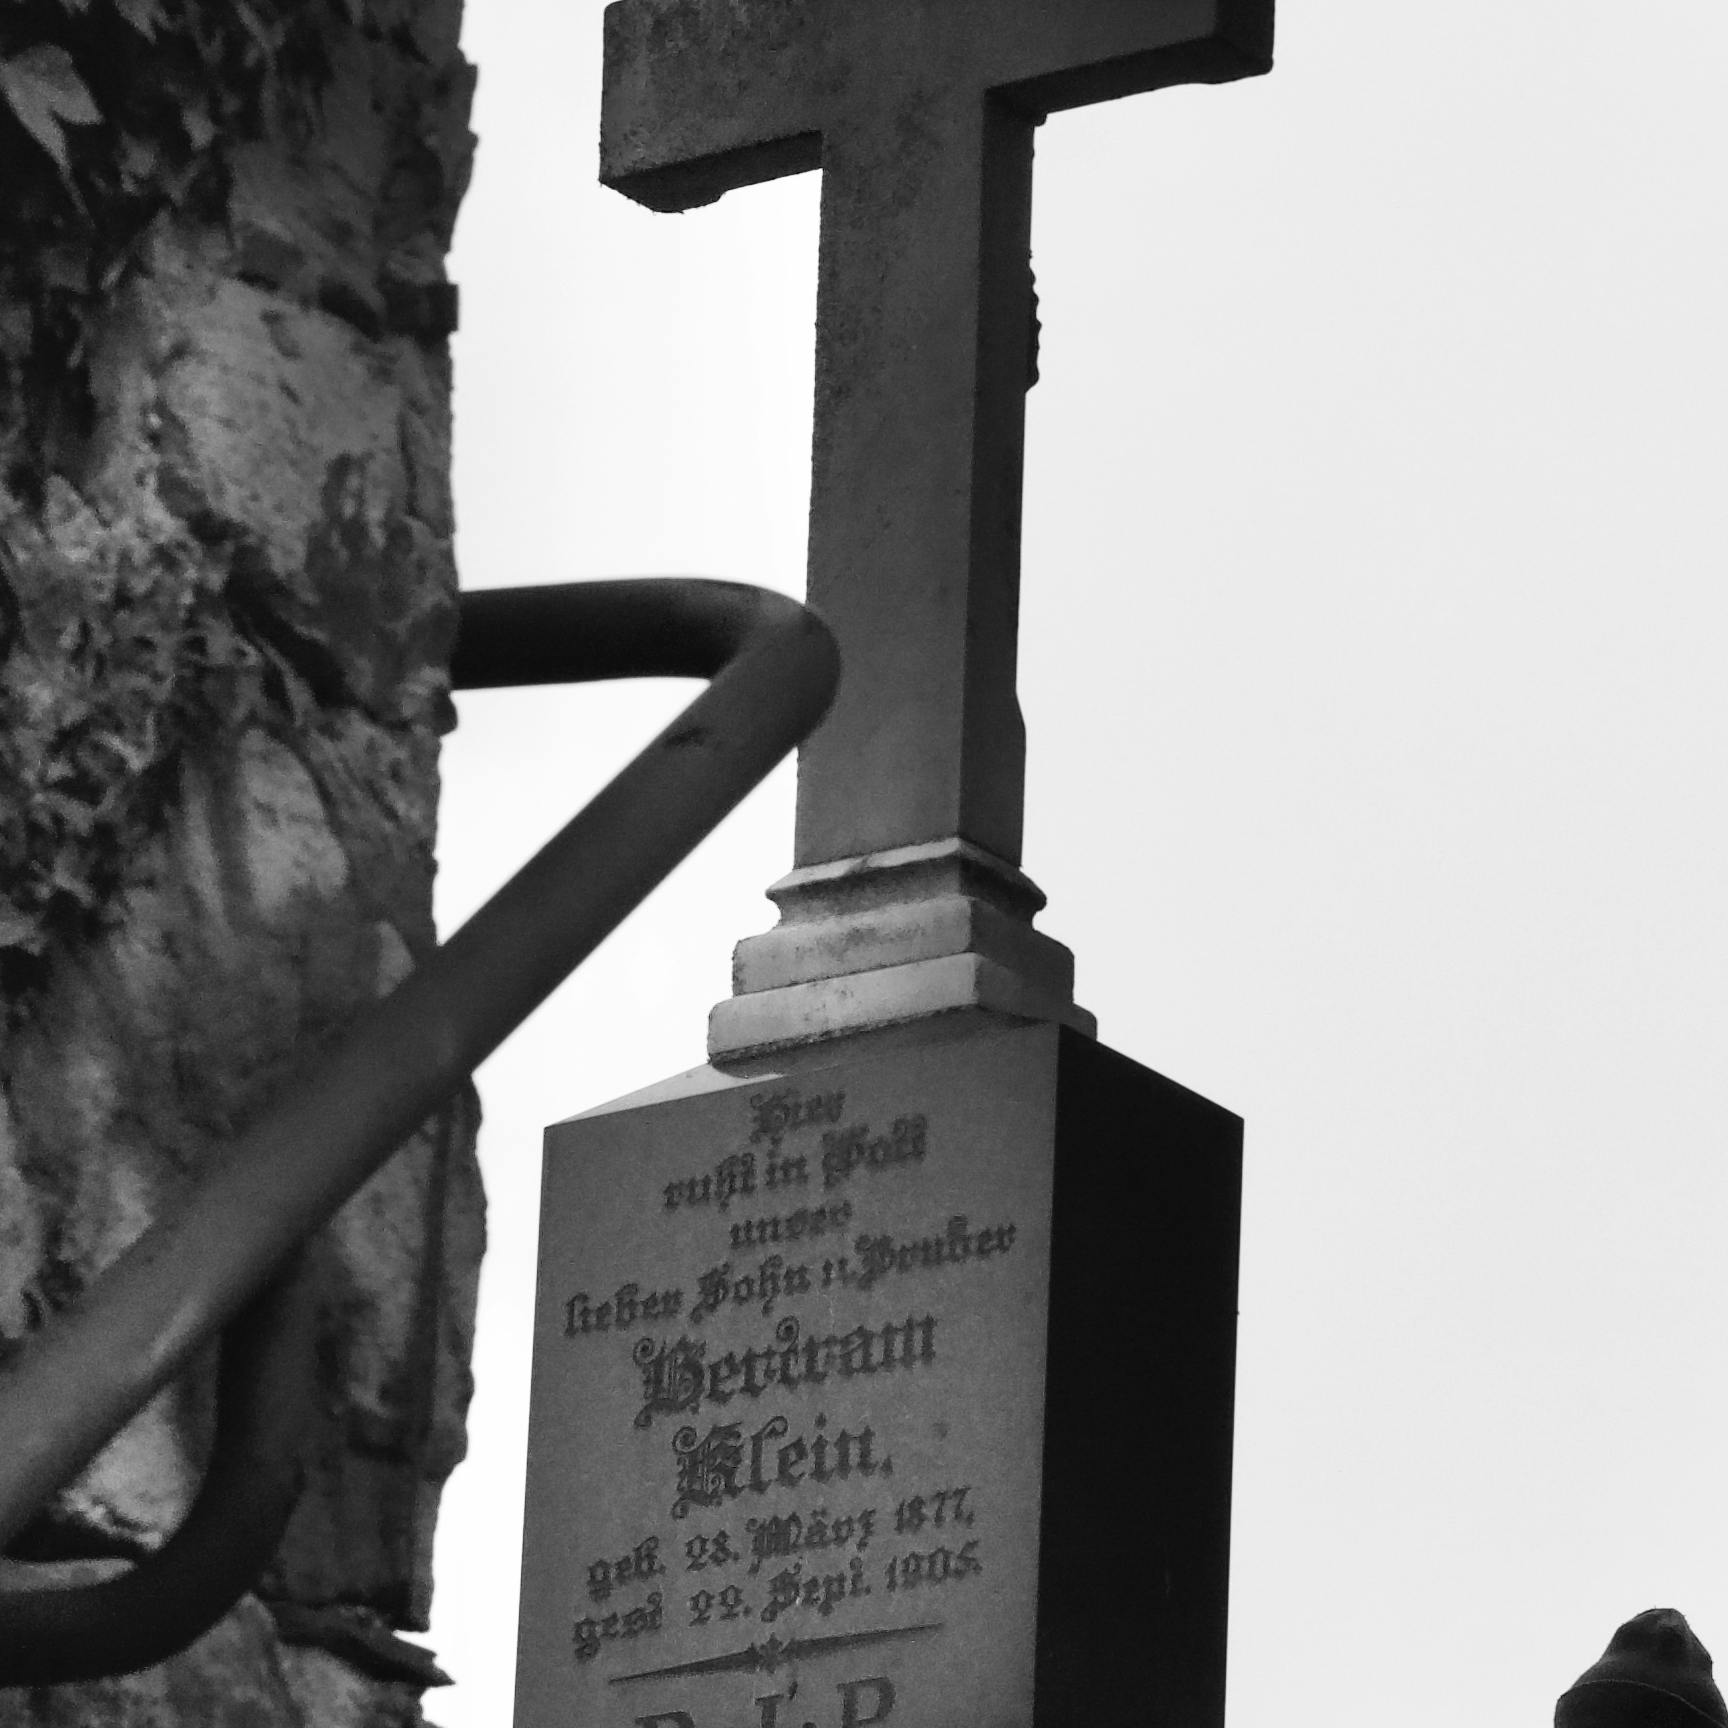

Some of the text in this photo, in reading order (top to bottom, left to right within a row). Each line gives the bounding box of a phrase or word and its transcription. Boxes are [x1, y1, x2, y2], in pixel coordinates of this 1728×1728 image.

[663, 1113, 928, 1212] ruht in Gott
[564, 1283, 684, 1338] lieber
[690, 1255, 811, 1322] Sohn
[855, 1214, 1017, 1291] Bruder
[746, 1507, 876, 1576] März
